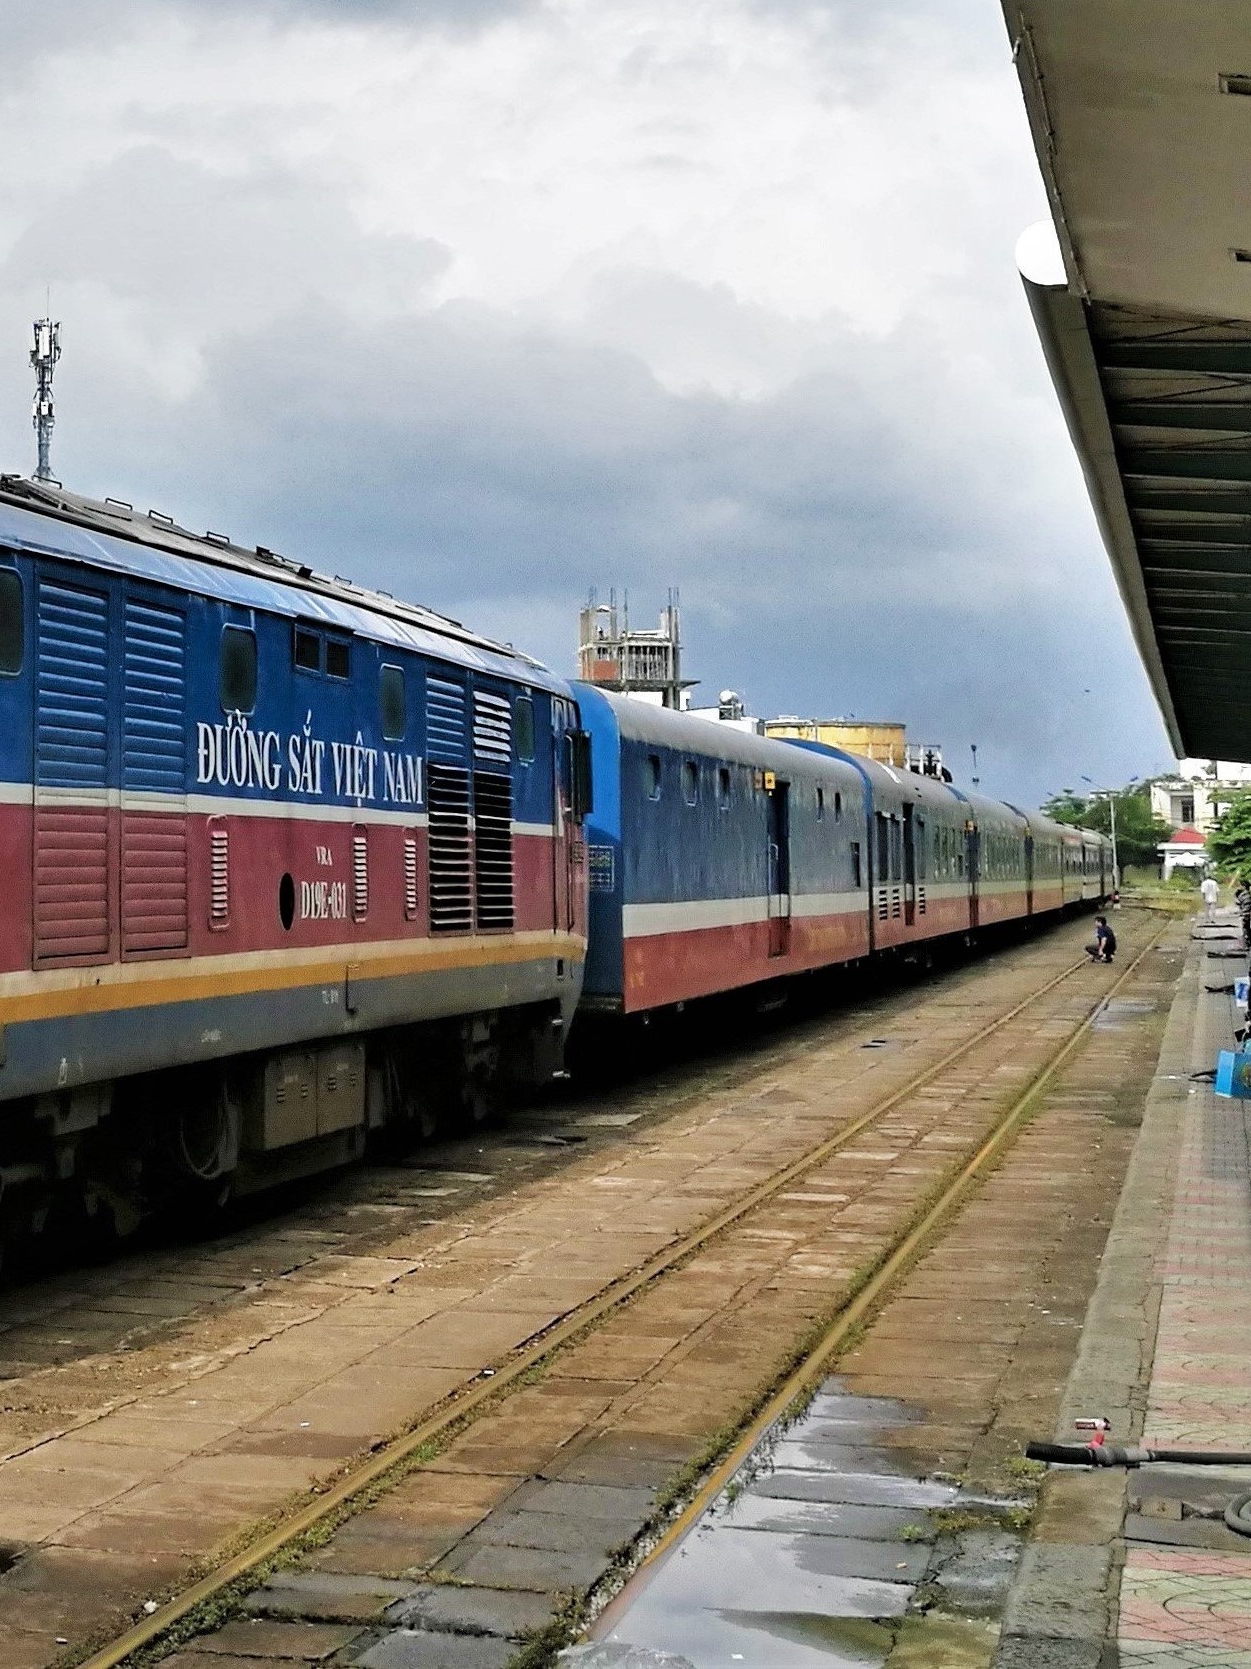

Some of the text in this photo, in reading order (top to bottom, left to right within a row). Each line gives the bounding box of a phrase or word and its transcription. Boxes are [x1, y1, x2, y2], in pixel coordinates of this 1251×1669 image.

[197, 709, 423, 807] ĐƯỜNG SẮT VIỆT NAM
